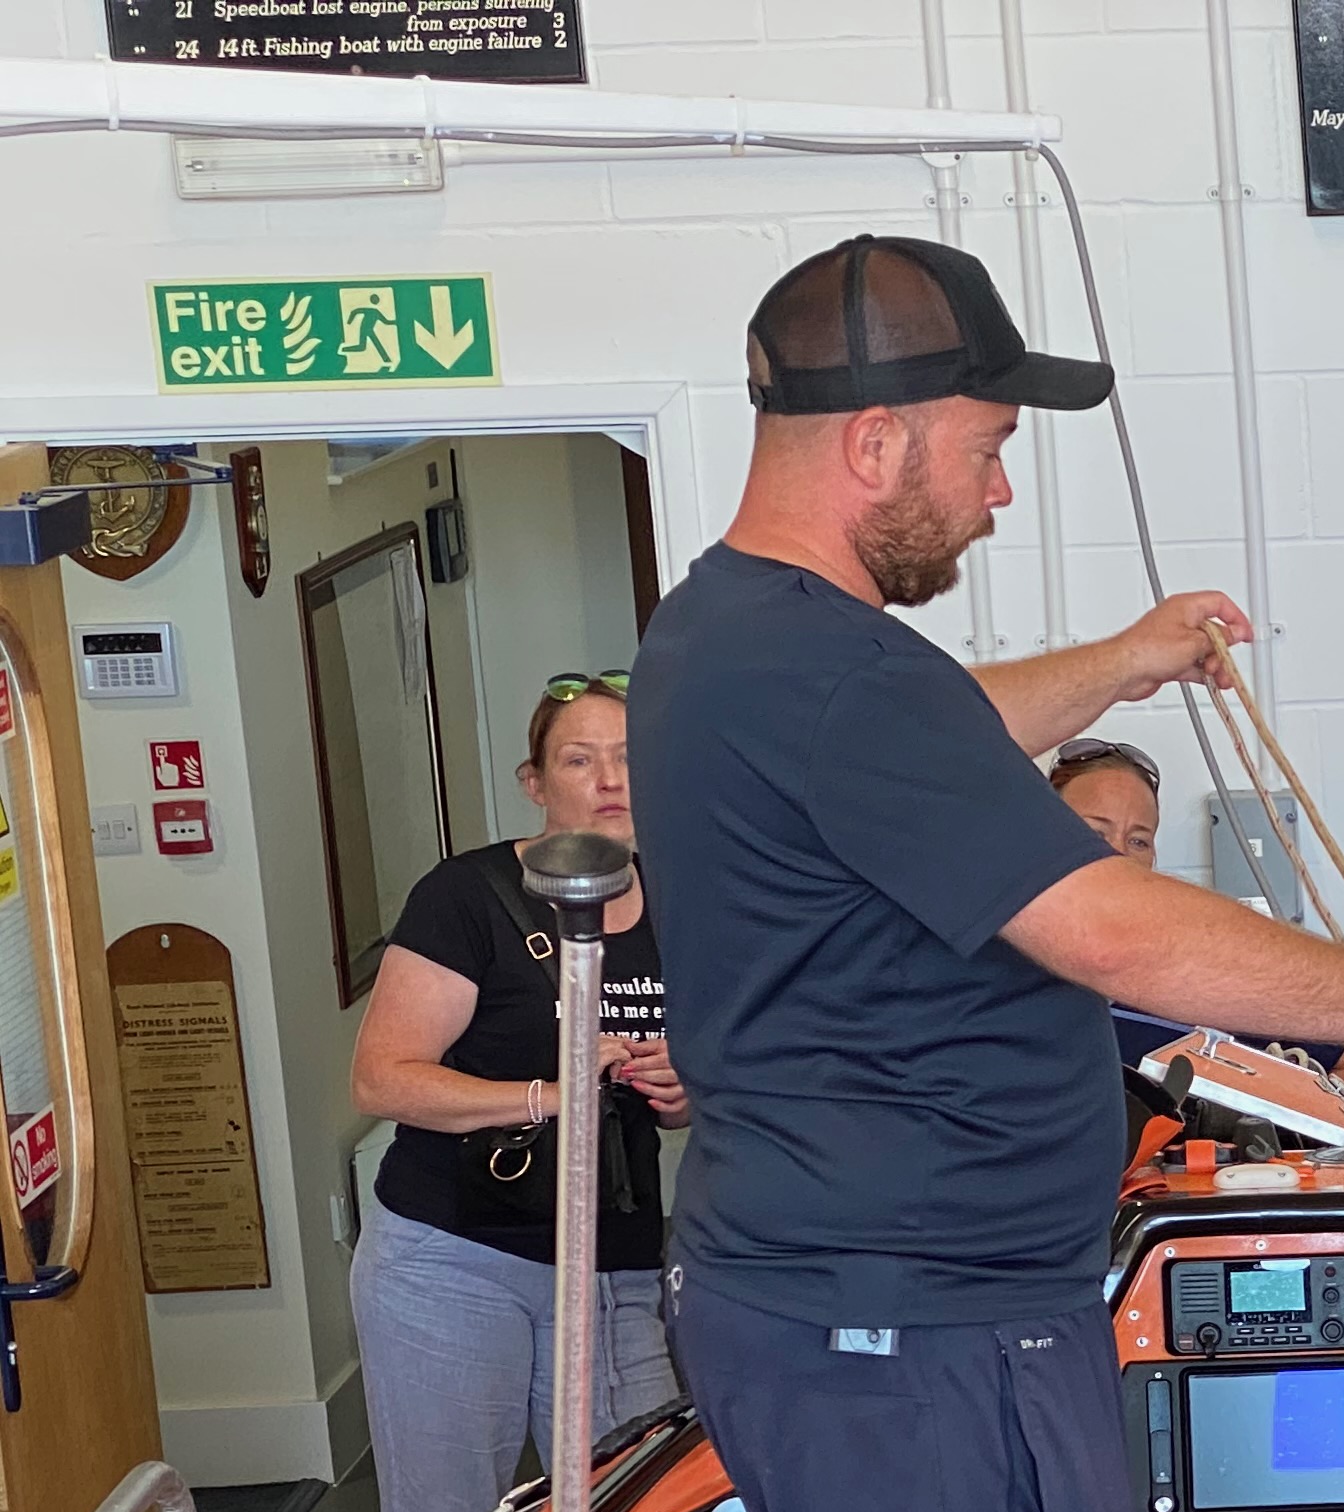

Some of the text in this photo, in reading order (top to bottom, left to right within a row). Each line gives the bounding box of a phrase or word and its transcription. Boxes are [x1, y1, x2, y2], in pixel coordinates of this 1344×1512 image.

[175, 1, 193, 18] 21
[214, 1, 305, 21] Speedboat
[311, 0, 344, 16] lost
[407, 13, 565, 33] from exposure 3
[175, 40, 200, 59] 24
[264, 38, 333, 59] Fishing
[339, 37, 381, 55] boat
[387, 35, 426, 53] with
[429, 36, 483, 56] engine
[487, 32, 543, 51] failure
[554, 32, 568, 48] 2
[165, 291, 267, 333] Fire
[171, 335, 266, 379] exit
[602, 977, 665, 996] couldn
[623, 1005, 650, 1019] me
[35, 1124, 46, 1147] No
